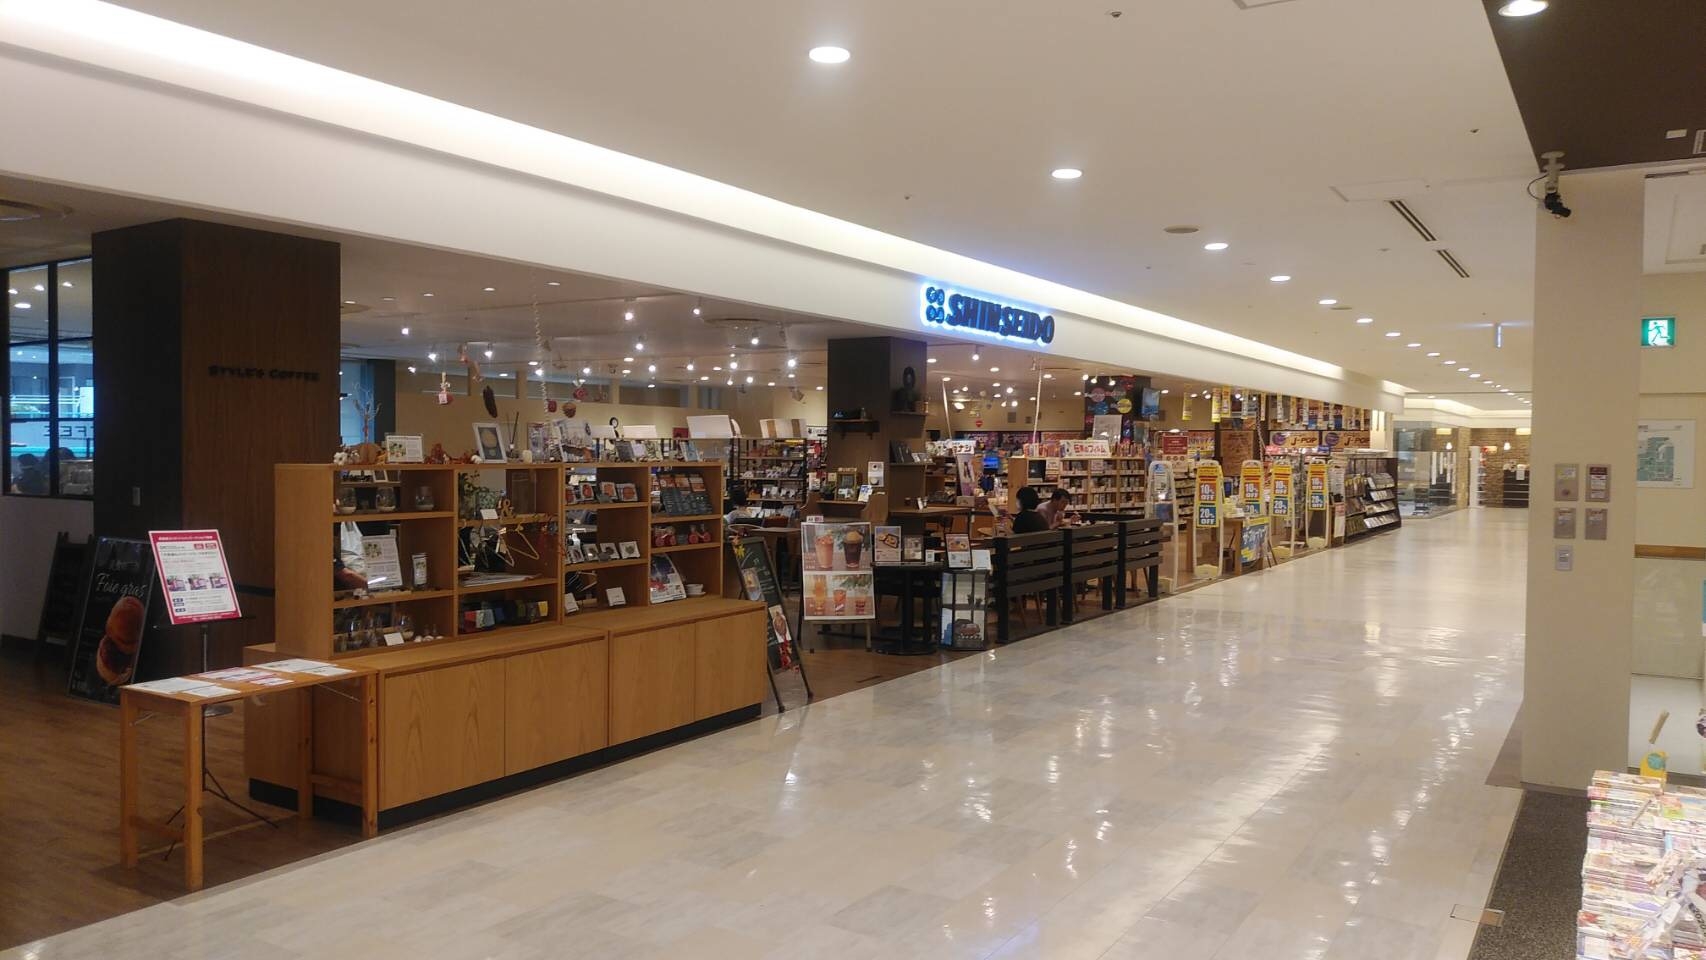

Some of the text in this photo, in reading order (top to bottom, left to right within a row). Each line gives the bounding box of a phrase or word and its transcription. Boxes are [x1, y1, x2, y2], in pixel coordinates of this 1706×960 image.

[946, 294, 1055, 343] SHINSEIDO
[208, 365, 320, 382] STYLE'S COFFEE
[1291, 437, 1317, 446] J-POP
[1344, 437, 1370, 446] J-POP
[96, 572, 149, 598] Foie gras
